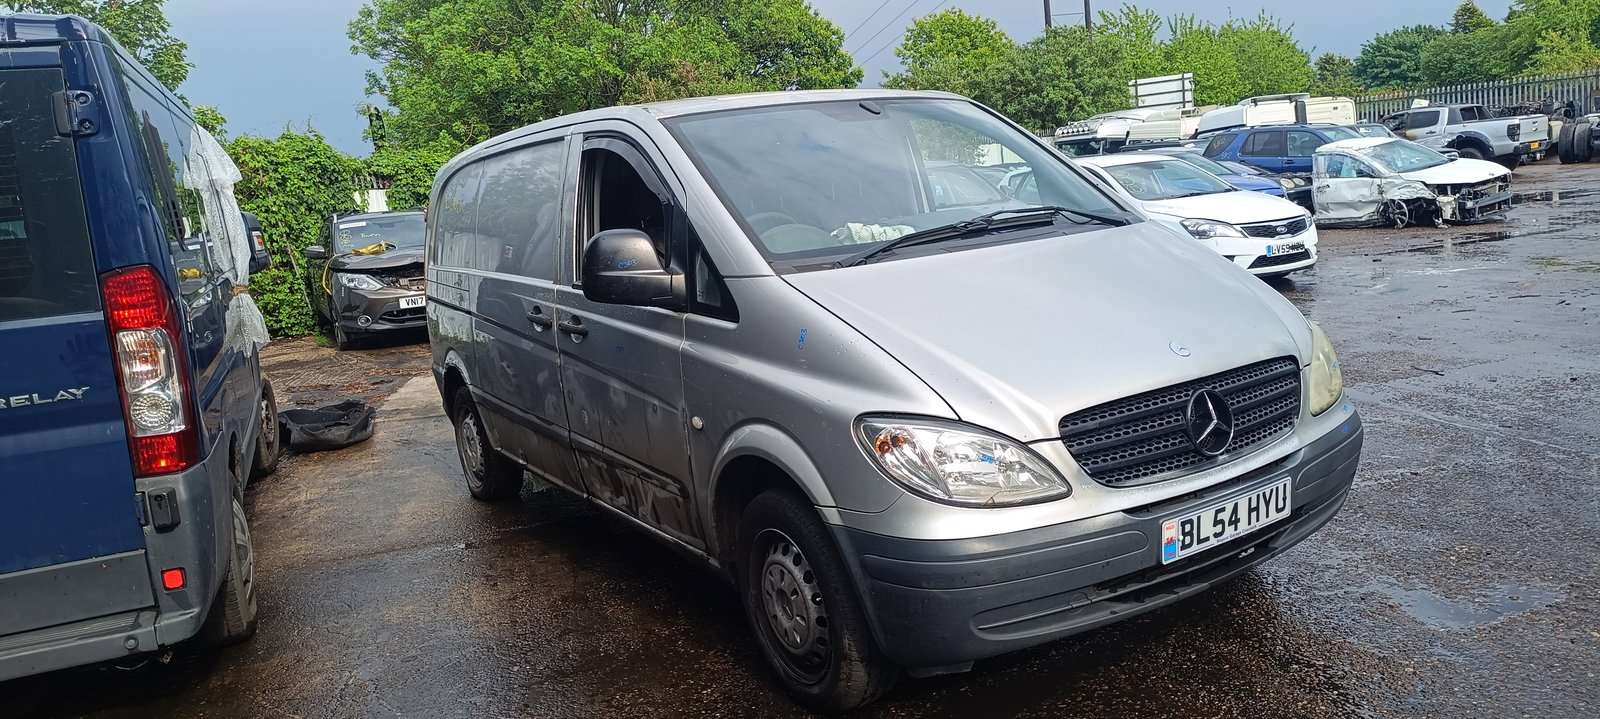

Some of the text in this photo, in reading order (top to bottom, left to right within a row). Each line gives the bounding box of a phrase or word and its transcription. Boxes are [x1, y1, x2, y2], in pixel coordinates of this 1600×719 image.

[1272, 244, 1290, 255] LV59
[405, 297, 424, 306] VN17
[1180, 483, 1287, 551] BL54 HYU
